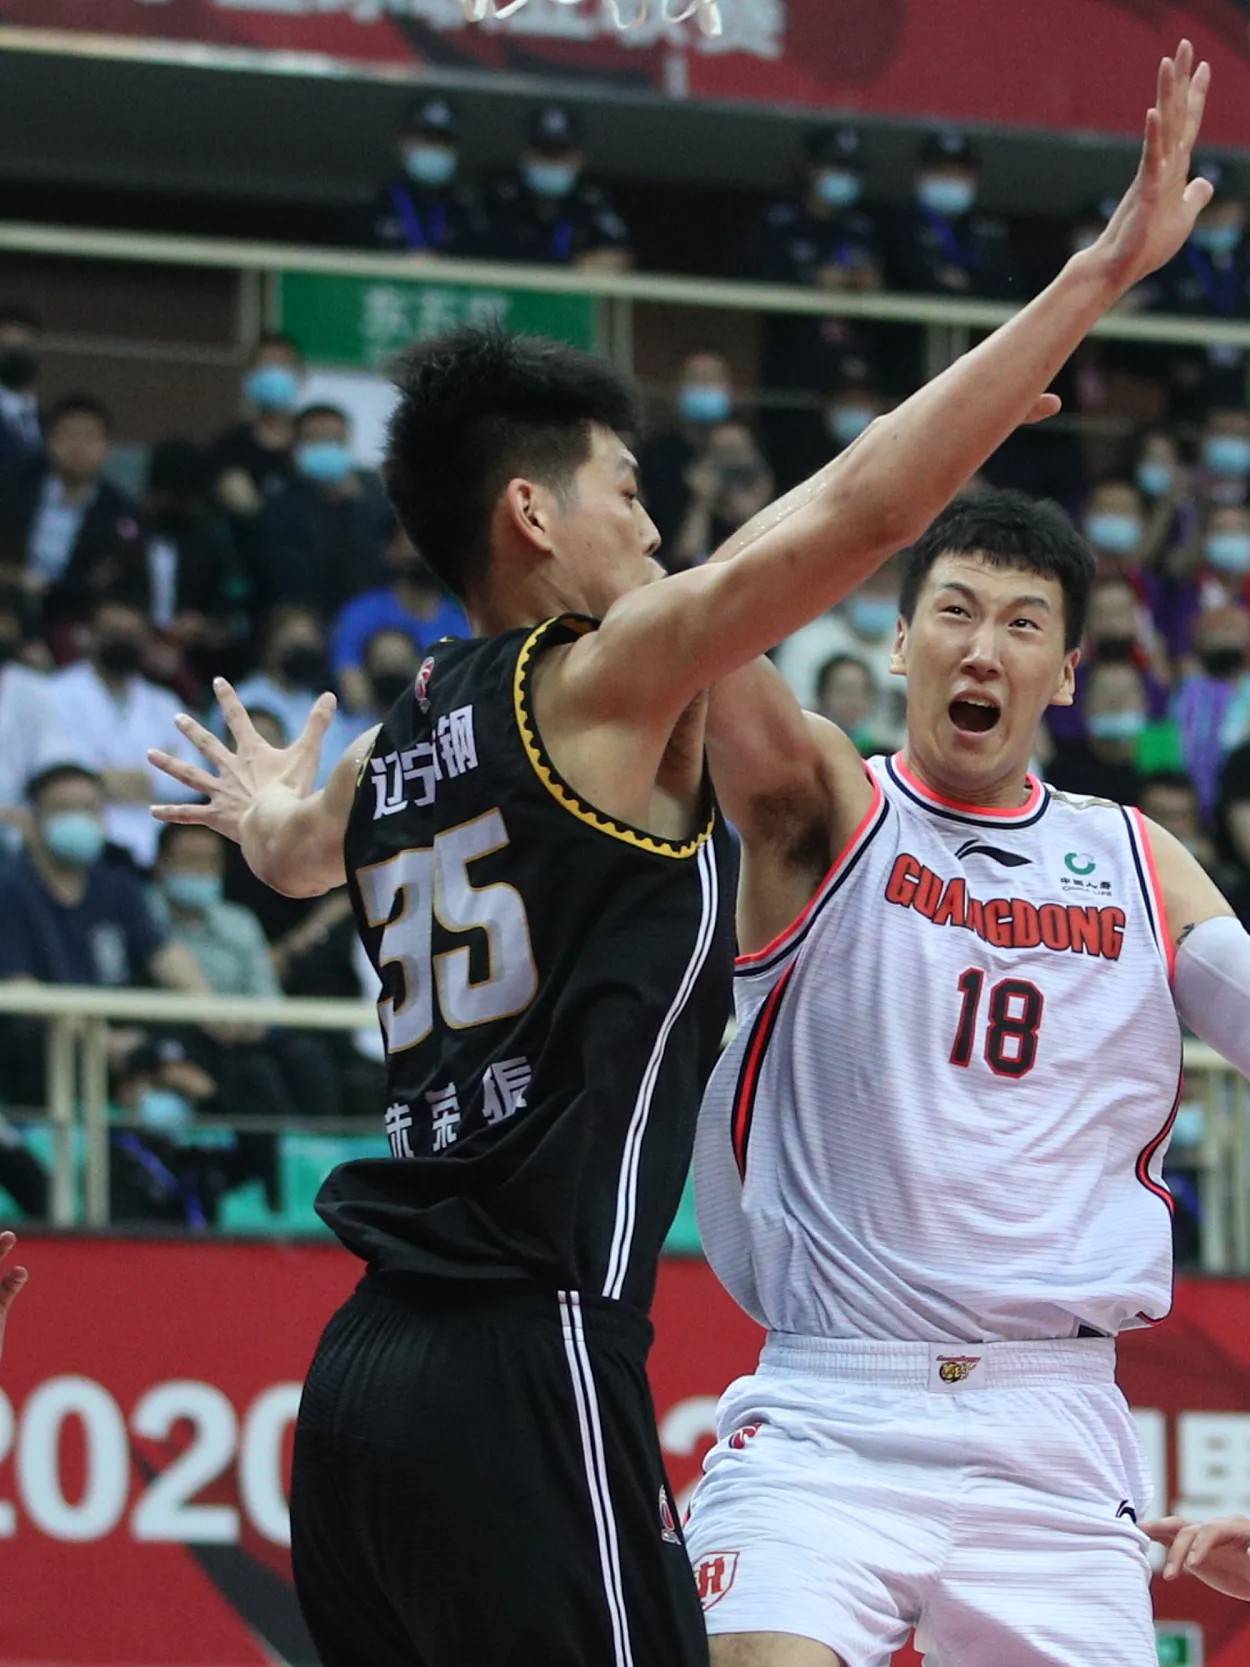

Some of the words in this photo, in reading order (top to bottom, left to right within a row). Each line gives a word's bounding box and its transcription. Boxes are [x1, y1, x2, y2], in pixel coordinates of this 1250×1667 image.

[370, 704, 479, 820] 辽宁钢
[355, 806, 539, 1055] 35
[949, 967, 1044, 1080] 18
